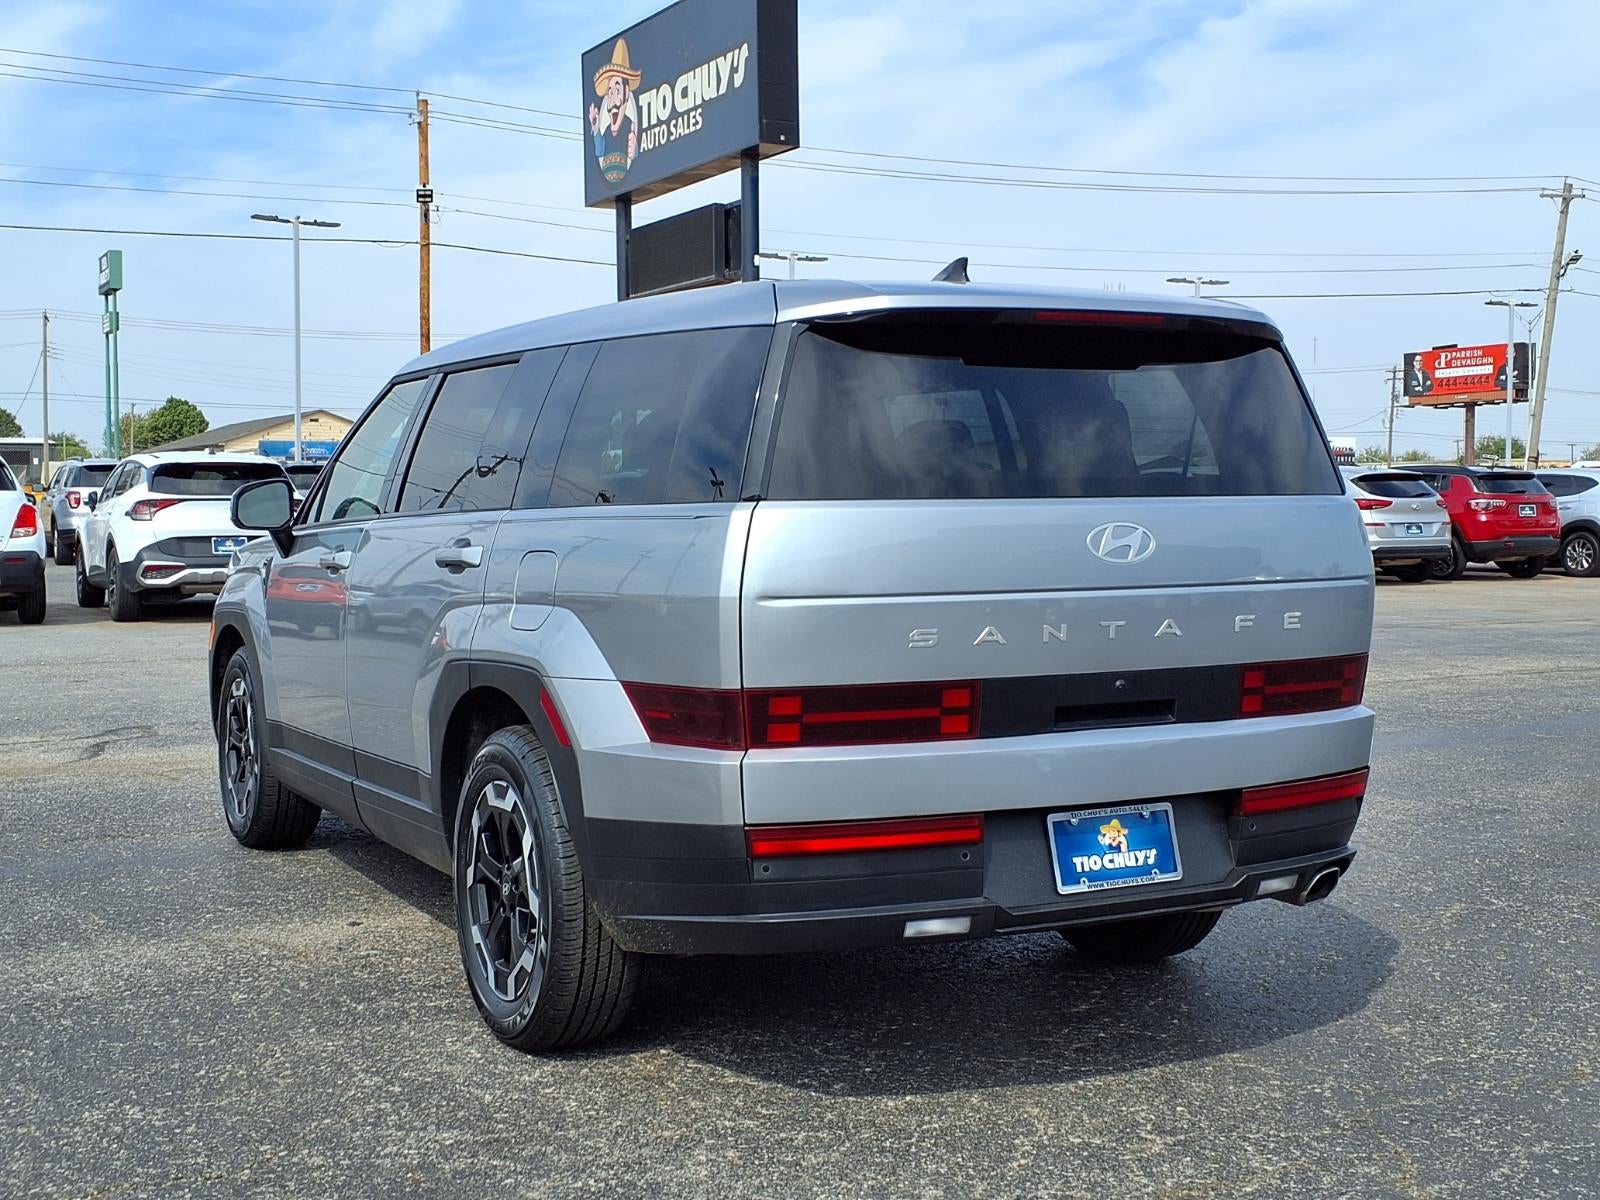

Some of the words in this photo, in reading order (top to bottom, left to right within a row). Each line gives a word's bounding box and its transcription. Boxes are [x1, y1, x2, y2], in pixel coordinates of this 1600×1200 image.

[639, 84, 672, 129] TIO
[674, 43, 749, 113] CHUY'S
[640, 125, 667, 153] AUTO
[670, 108, 703, 141] SALES
[1451, 349, 1483, 359] PARRISH
[1451, 357, 1494, 367] DEVAUGHN
[1437, 375, 1490, 388] 444-4444
[907, 618, 1184, 649] SANTA
[1233, 611, 1302, 633] FE
[1109, 806, 1127, 815] AUTO
[1073, 854, 1102, 873] TIO
[1103, 848, 1158, 869] CHUY'S
[1087, 876, 1156, 889] WWW.TIOCHUYS.COM
